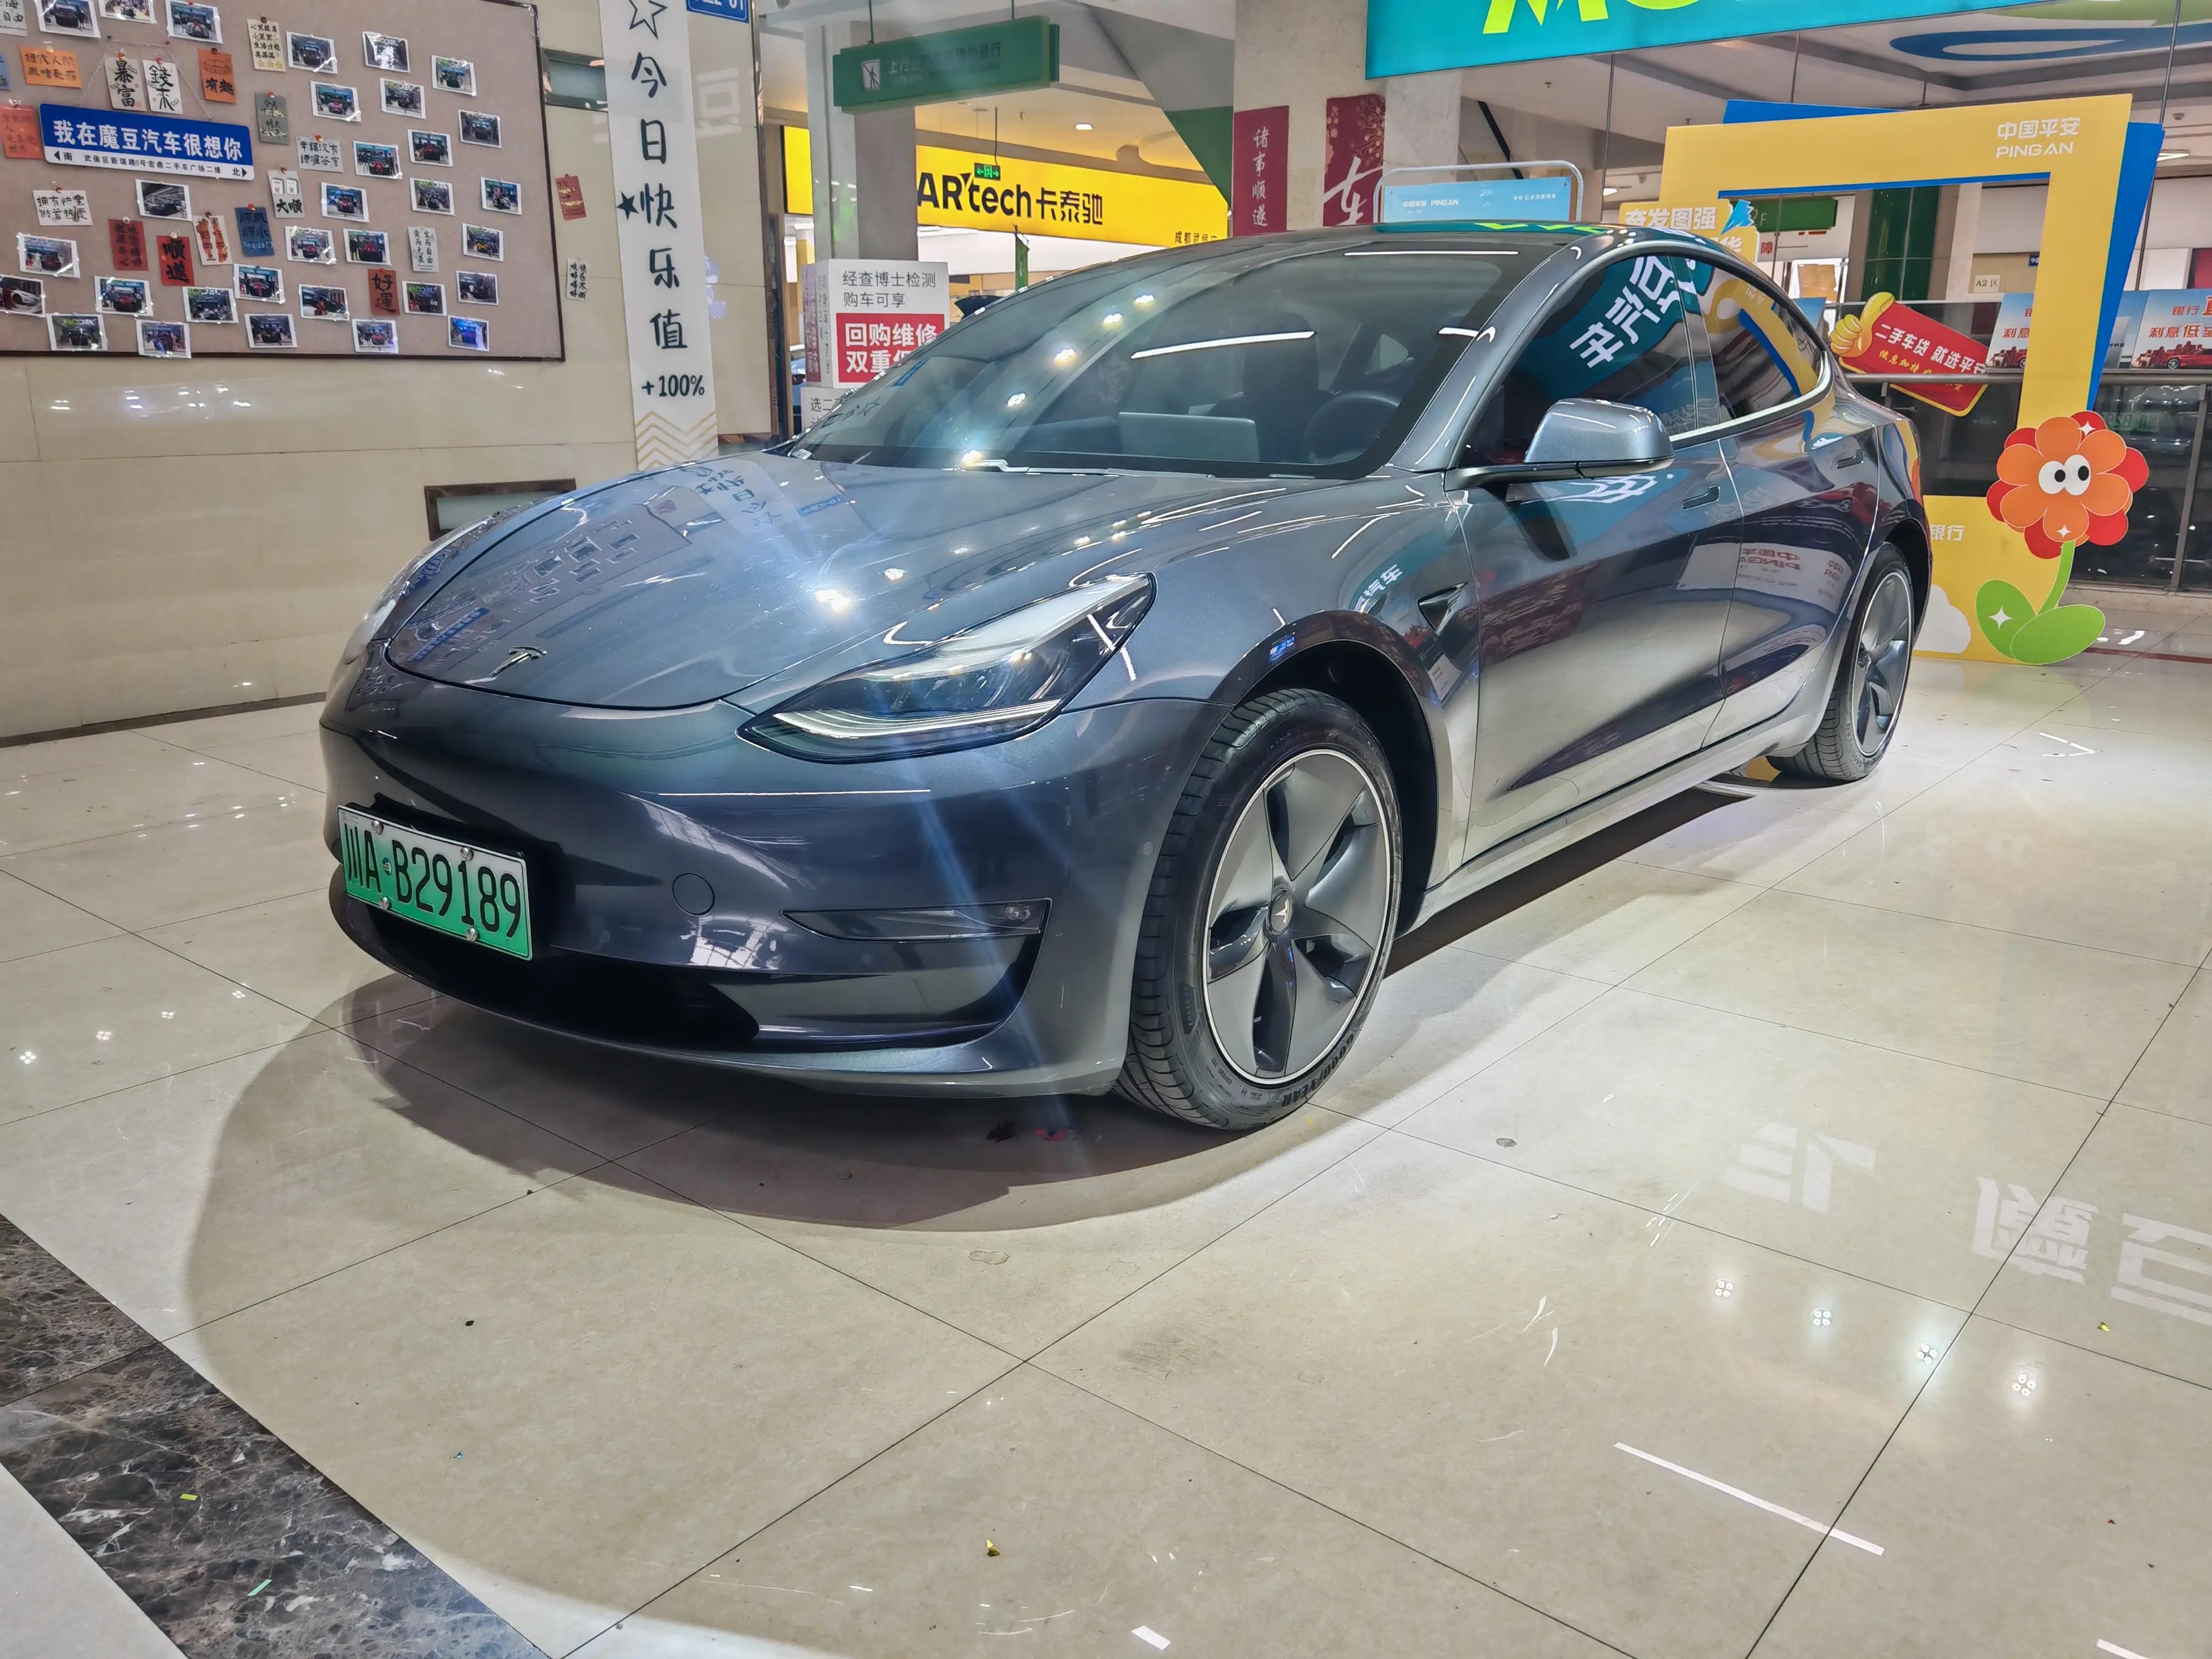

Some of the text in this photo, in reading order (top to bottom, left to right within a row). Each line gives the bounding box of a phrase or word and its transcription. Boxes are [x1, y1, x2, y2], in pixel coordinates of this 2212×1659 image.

[53, 119, 243, 161] 我在魔豆汽车很想你
[1997, 117, 2080, 140] 中国平安
[1995, 141, 2074, 158] PINGAN
[63, 152, 73, 161] 南
[232, 167, 241, 177] 北
[1251, 126, 1271, 227] 诸事顺遂
[631, 52, 688, 349] 今日快乐值
[1036, 187, 1103, 225] 卡泰驰
[1625, 207, 1717, 231] 奋发图强
[1761, 241, 1773, 255] 障
[842, 269, 937, 288] 经查博士检测
[843, 292, 907, 308] 购车可享
[2171, 305, 2200, 316] 银行
[845, 322, 938, 348] 回购维修
[1875, 323, 1931, 356] 二手车贷
[641, 374, 705, 397] +100%
